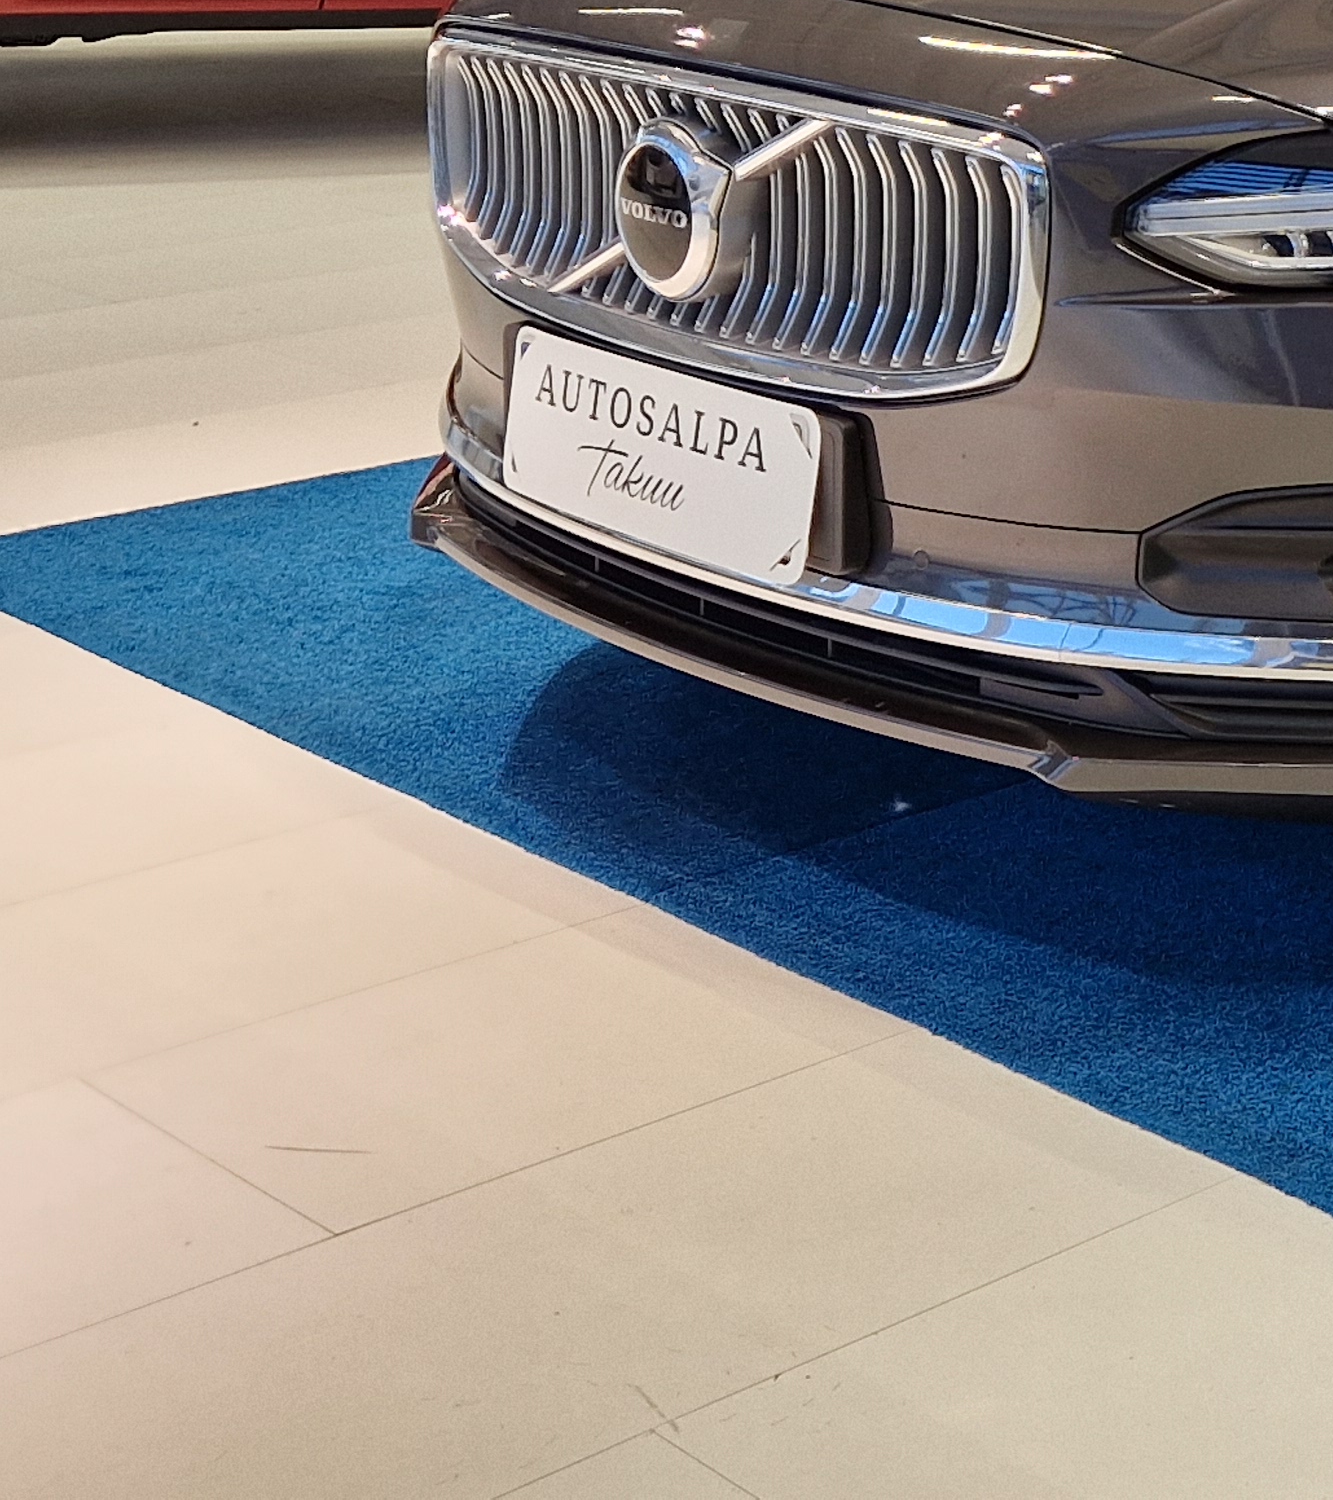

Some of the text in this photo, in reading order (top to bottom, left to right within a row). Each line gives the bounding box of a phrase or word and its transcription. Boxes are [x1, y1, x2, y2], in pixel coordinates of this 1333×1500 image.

[620, 197, 688, 229] VOLVO
[535, 364, 767, 473] AUTOSALPA
[577, 438, 685, 511] Takuu
